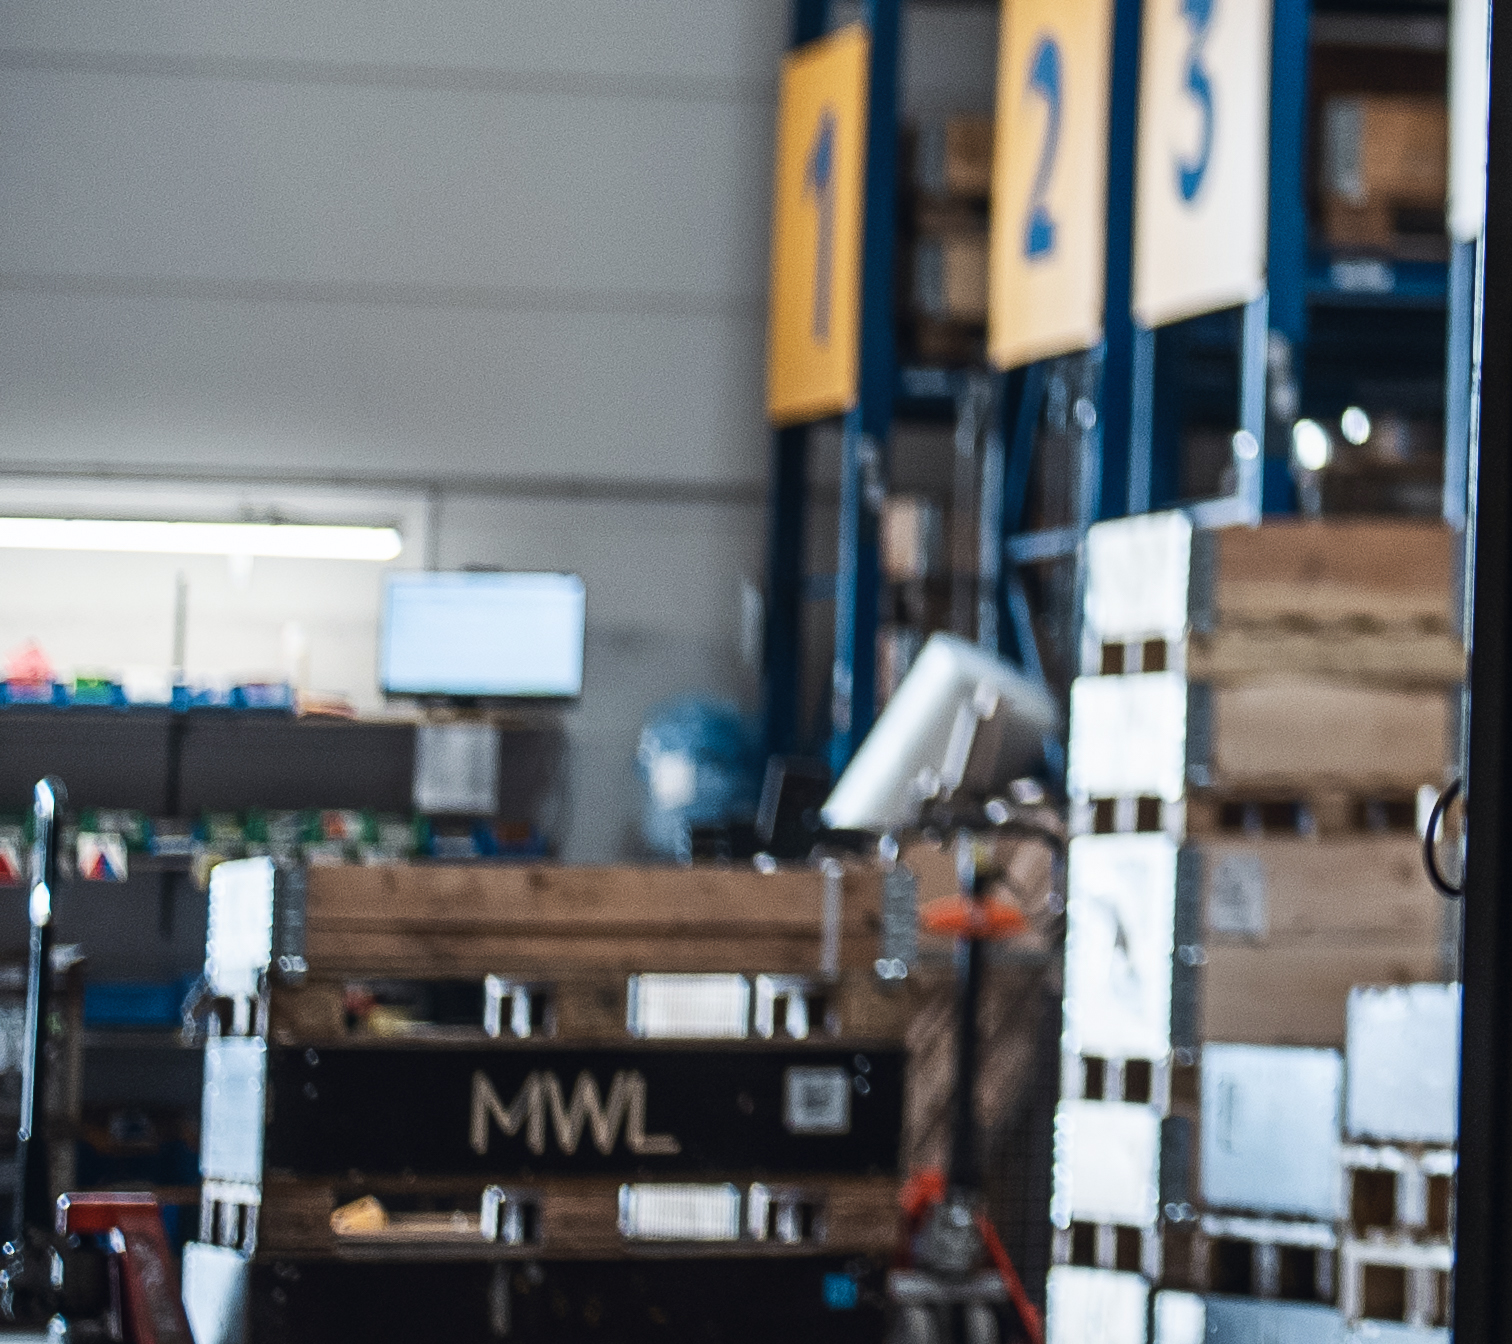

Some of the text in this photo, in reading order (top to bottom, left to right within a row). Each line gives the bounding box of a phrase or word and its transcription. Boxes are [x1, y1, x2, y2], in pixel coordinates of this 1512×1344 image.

[803, 107, 836, 352] 1
[1023, 31, 1062, 265] 2
[470, 1070, 680, 1156] MWL
